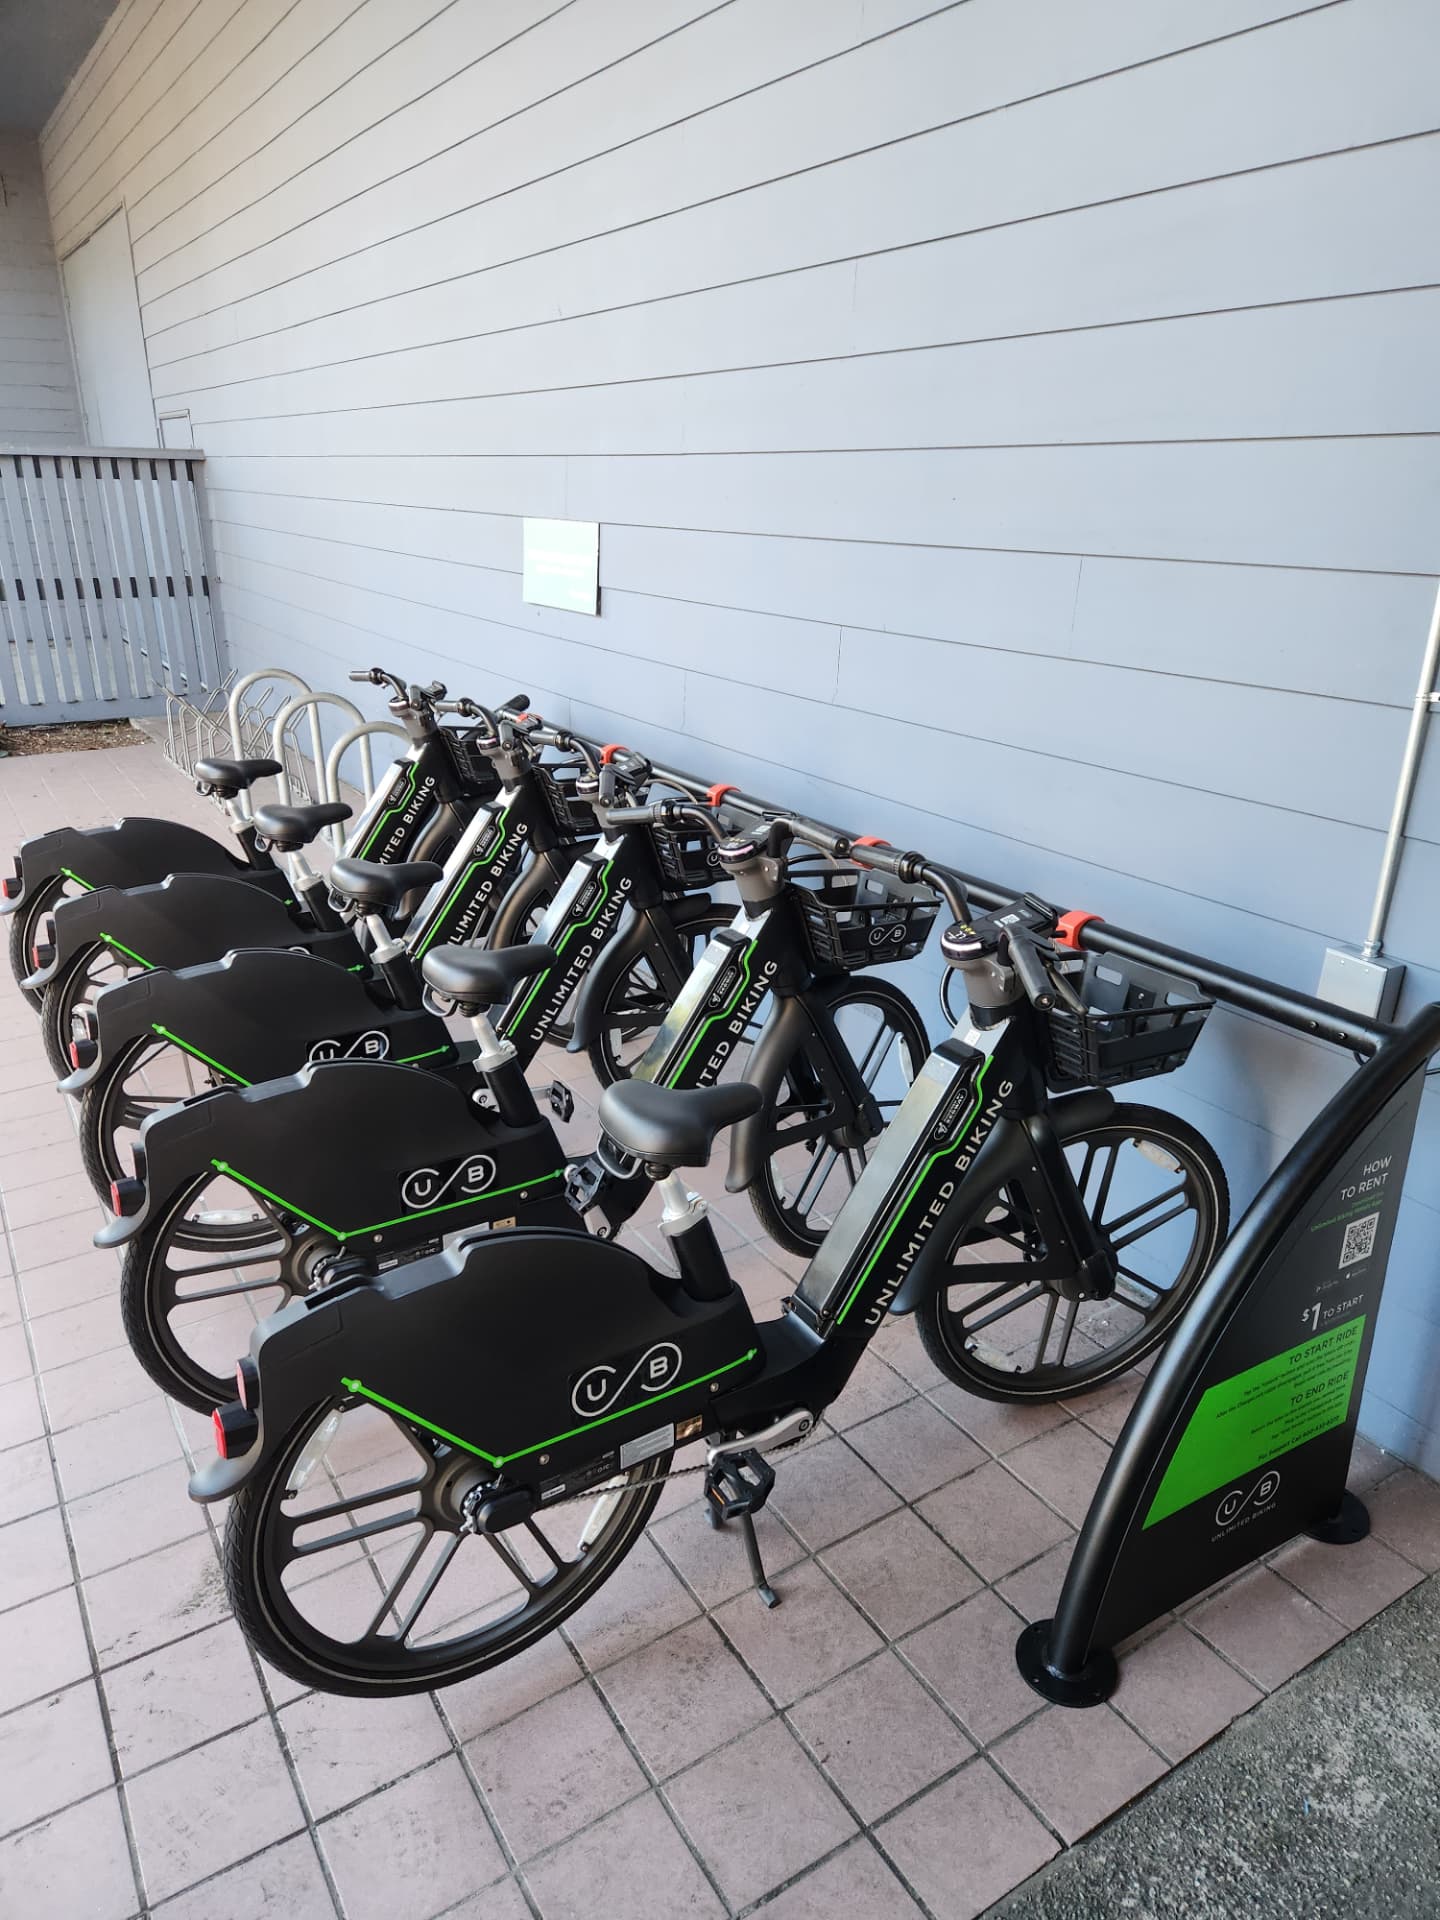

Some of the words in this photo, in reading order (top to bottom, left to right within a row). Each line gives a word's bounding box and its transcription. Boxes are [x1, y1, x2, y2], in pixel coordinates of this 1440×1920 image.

[378, 827, 405, 865] MITED
[403, 776, 436, 825] BIKING
[449, 881, 493, 944] LIMITED
[491, 823, 528, 877] BIKING
[530, 945, 593, 1041] UNLIMITED
[591, 877, 633, 940] BIKING
[728, 960, 778, 1035] BIKING
[1341, 1185, 1356, 1200] TO
[1358, 1172, 1389, 1194] RENT
[1363, 1155, 1392, 1176] HOW
[864, 1181, 955, 1326] UNLIMITED
[955, 1079, 1014, 1172] BIKING
[1323, 1307, 1335, 1319] TO
[1335, 1294, 1365, 1313] START
[1289, 1353, 1303, 1366] TO
[1303, 1337, 1334, 1359] START
[1335, 1326, 1359, 1344] RIDE
[1290, 1394, 1304, 1407] TO
[1305, 1383, 1327, 1399] END
[1327, 1370, 1350, 1387] RIDE
